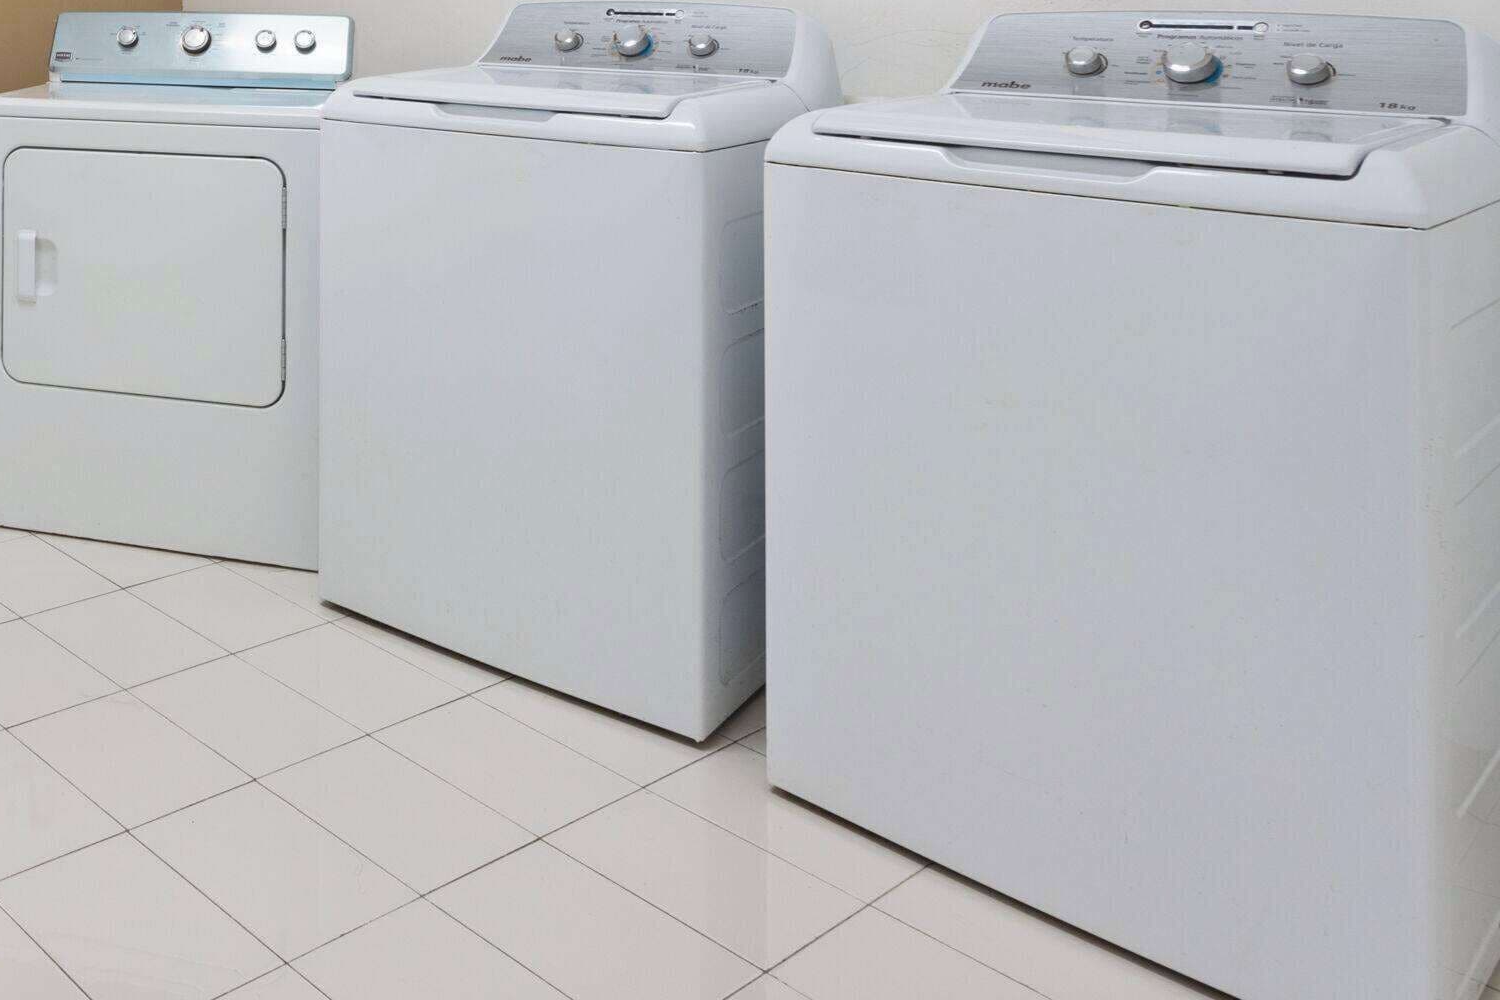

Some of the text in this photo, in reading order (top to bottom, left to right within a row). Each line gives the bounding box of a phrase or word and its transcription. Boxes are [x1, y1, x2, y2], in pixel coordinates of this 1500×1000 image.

[1318, 41, 1344, 49] Carga
[500, 55, 532, 63] mabe
[981, 80, 1032, 90] mabe
[1378, 102, 1399, 110] 18
